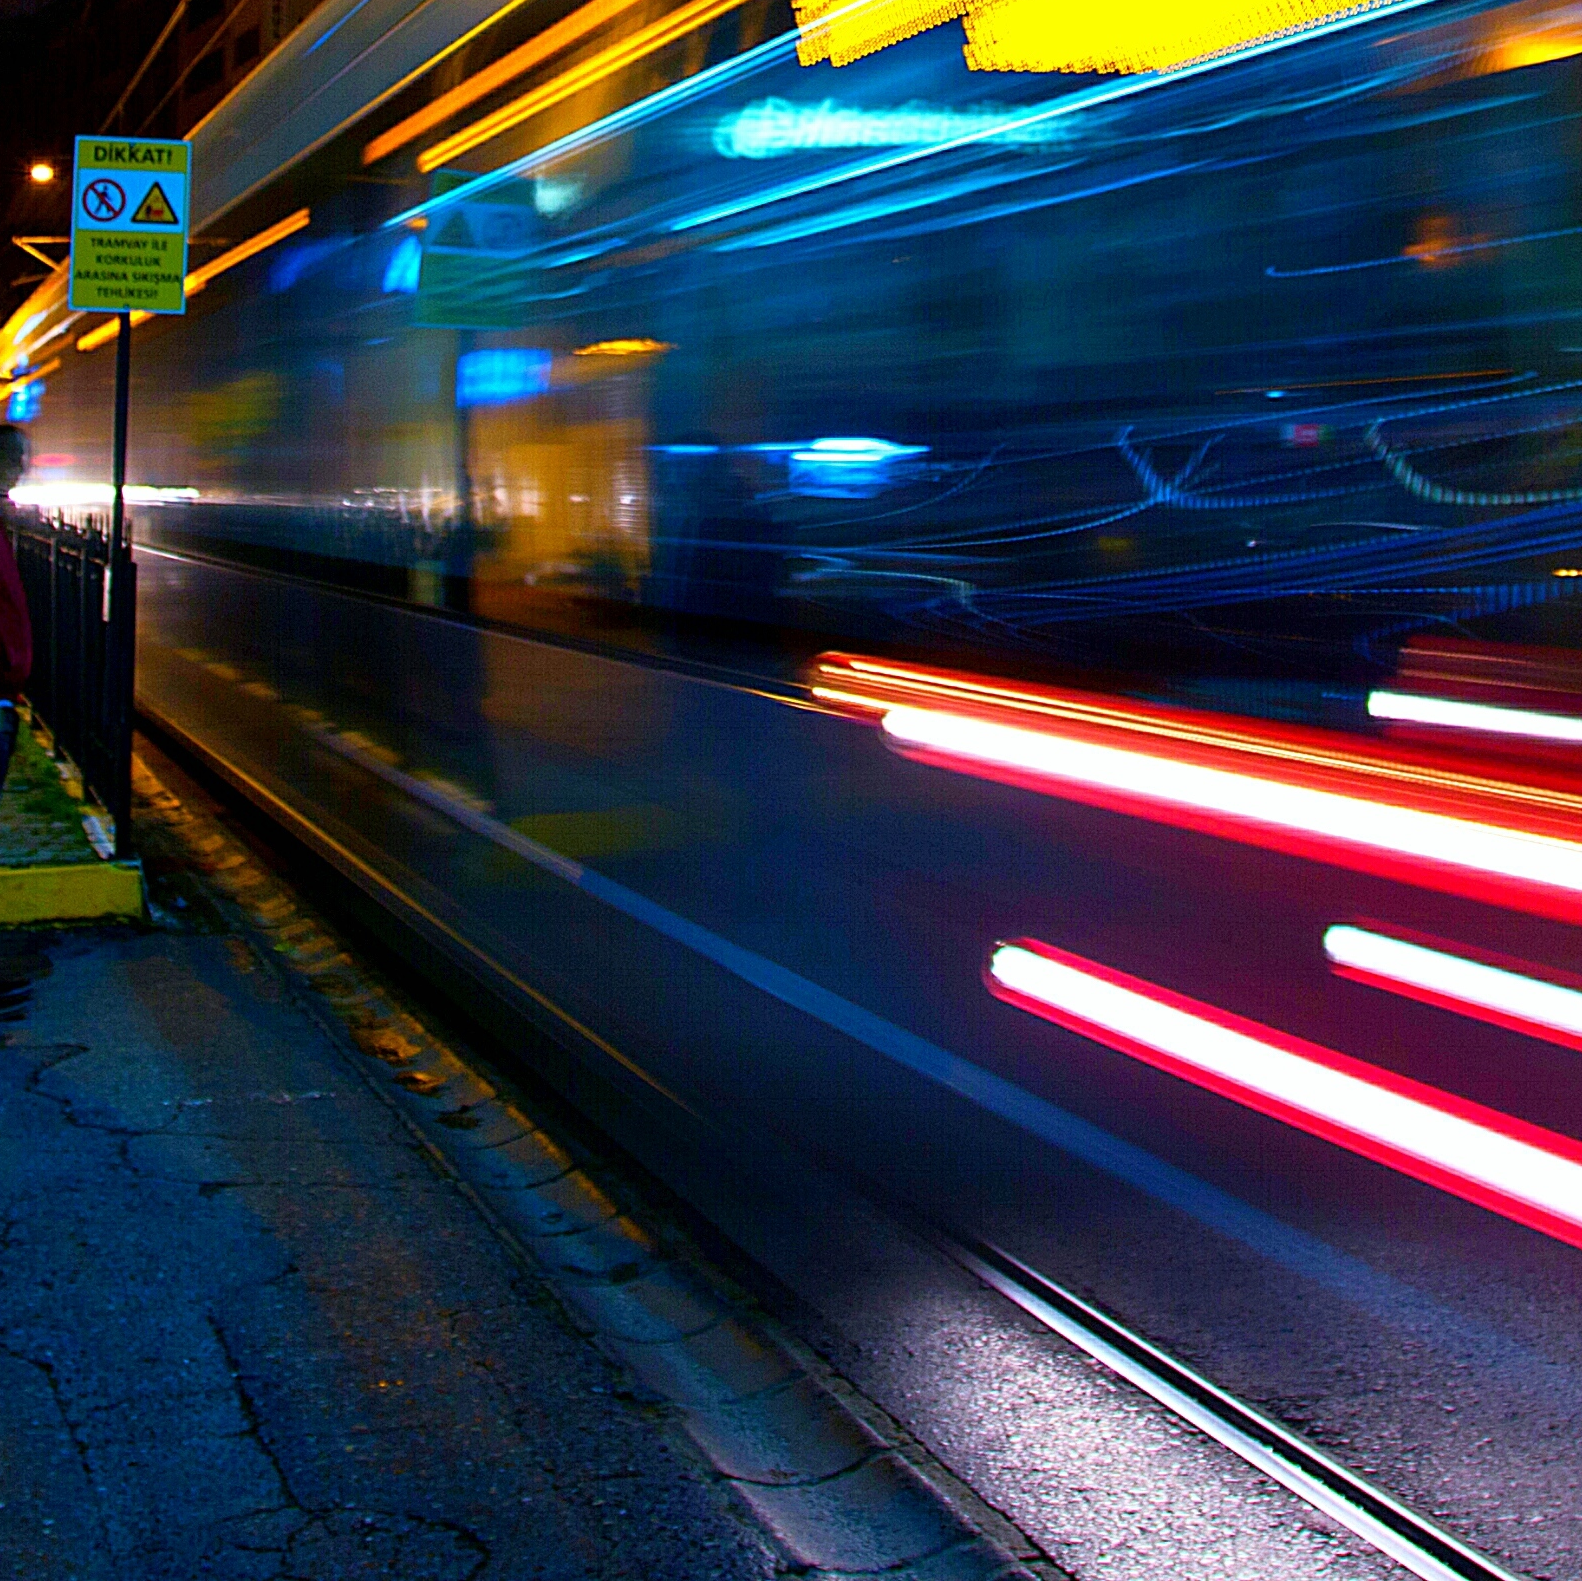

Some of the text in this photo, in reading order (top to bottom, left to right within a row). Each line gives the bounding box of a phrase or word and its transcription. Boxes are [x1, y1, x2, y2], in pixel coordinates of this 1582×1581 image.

[94, 145, 173, 165] DİKKAT!
[91, 237, 149, 250] TRAMVAY
[96, 254, 161, 266] KORKULUK
[75, 269, 128, 281] ARASINA
